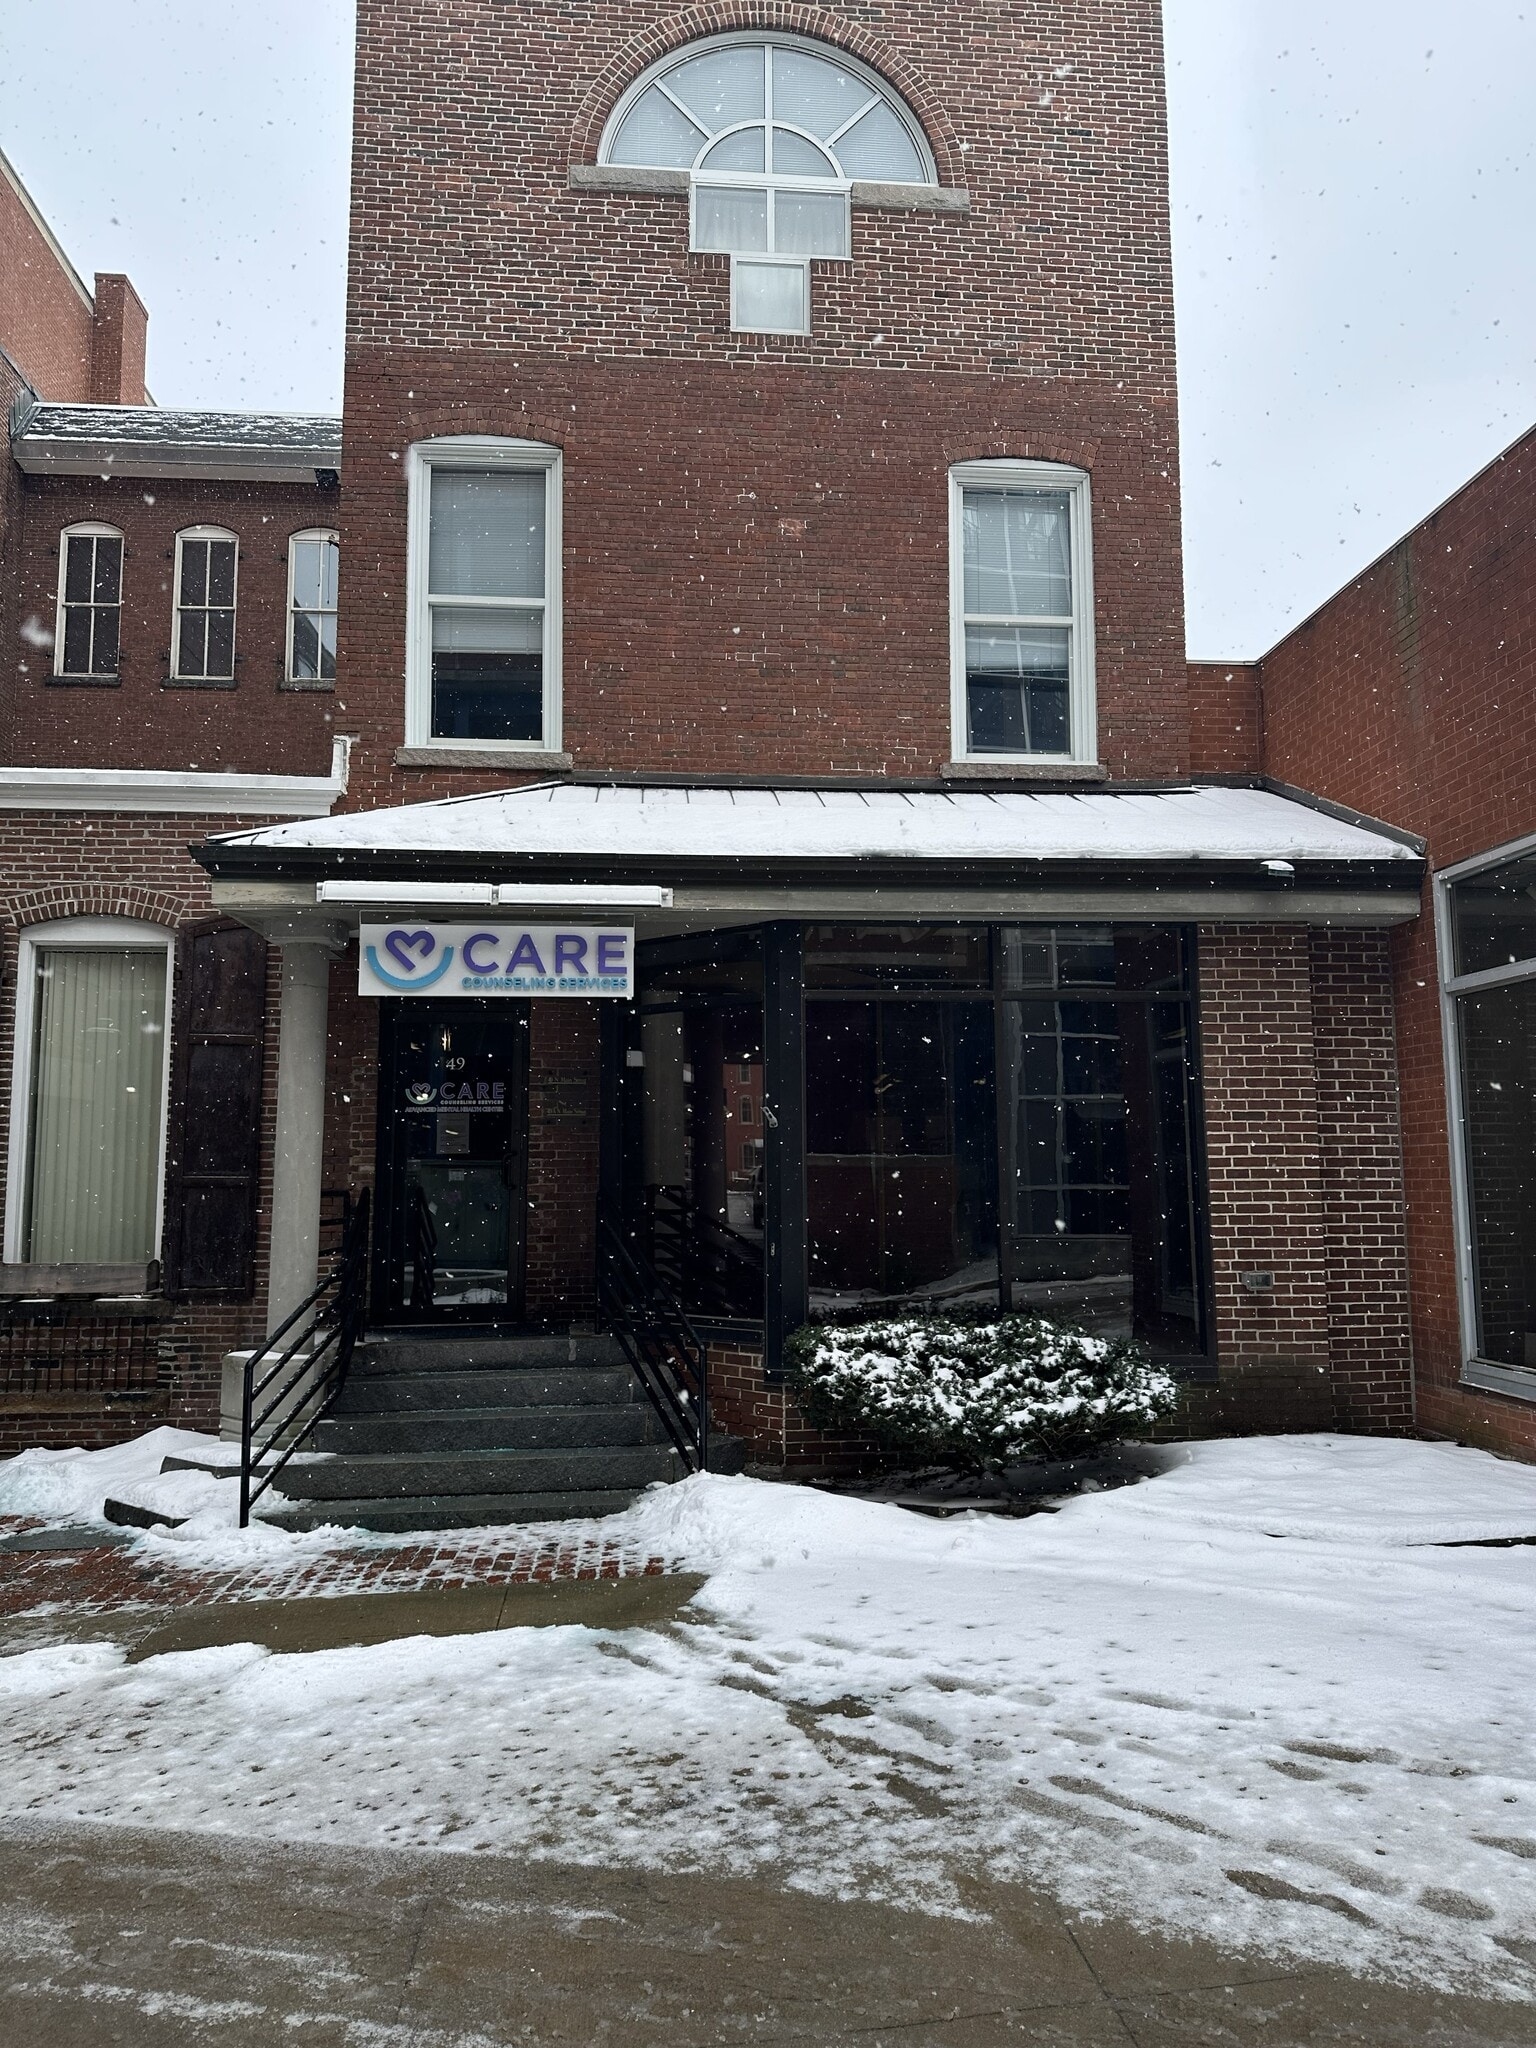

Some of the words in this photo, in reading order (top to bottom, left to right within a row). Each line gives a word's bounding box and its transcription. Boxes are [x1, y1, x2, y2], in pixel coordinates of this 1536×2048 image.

[462, 933, 628, 975] CARE
[461, 977, 556, 989] COUNSELING
[558, 977, 628, 990] SERVICES
[445, 1057, 465, 1071] 49
[440, 1082, 505, 1100] CARE
